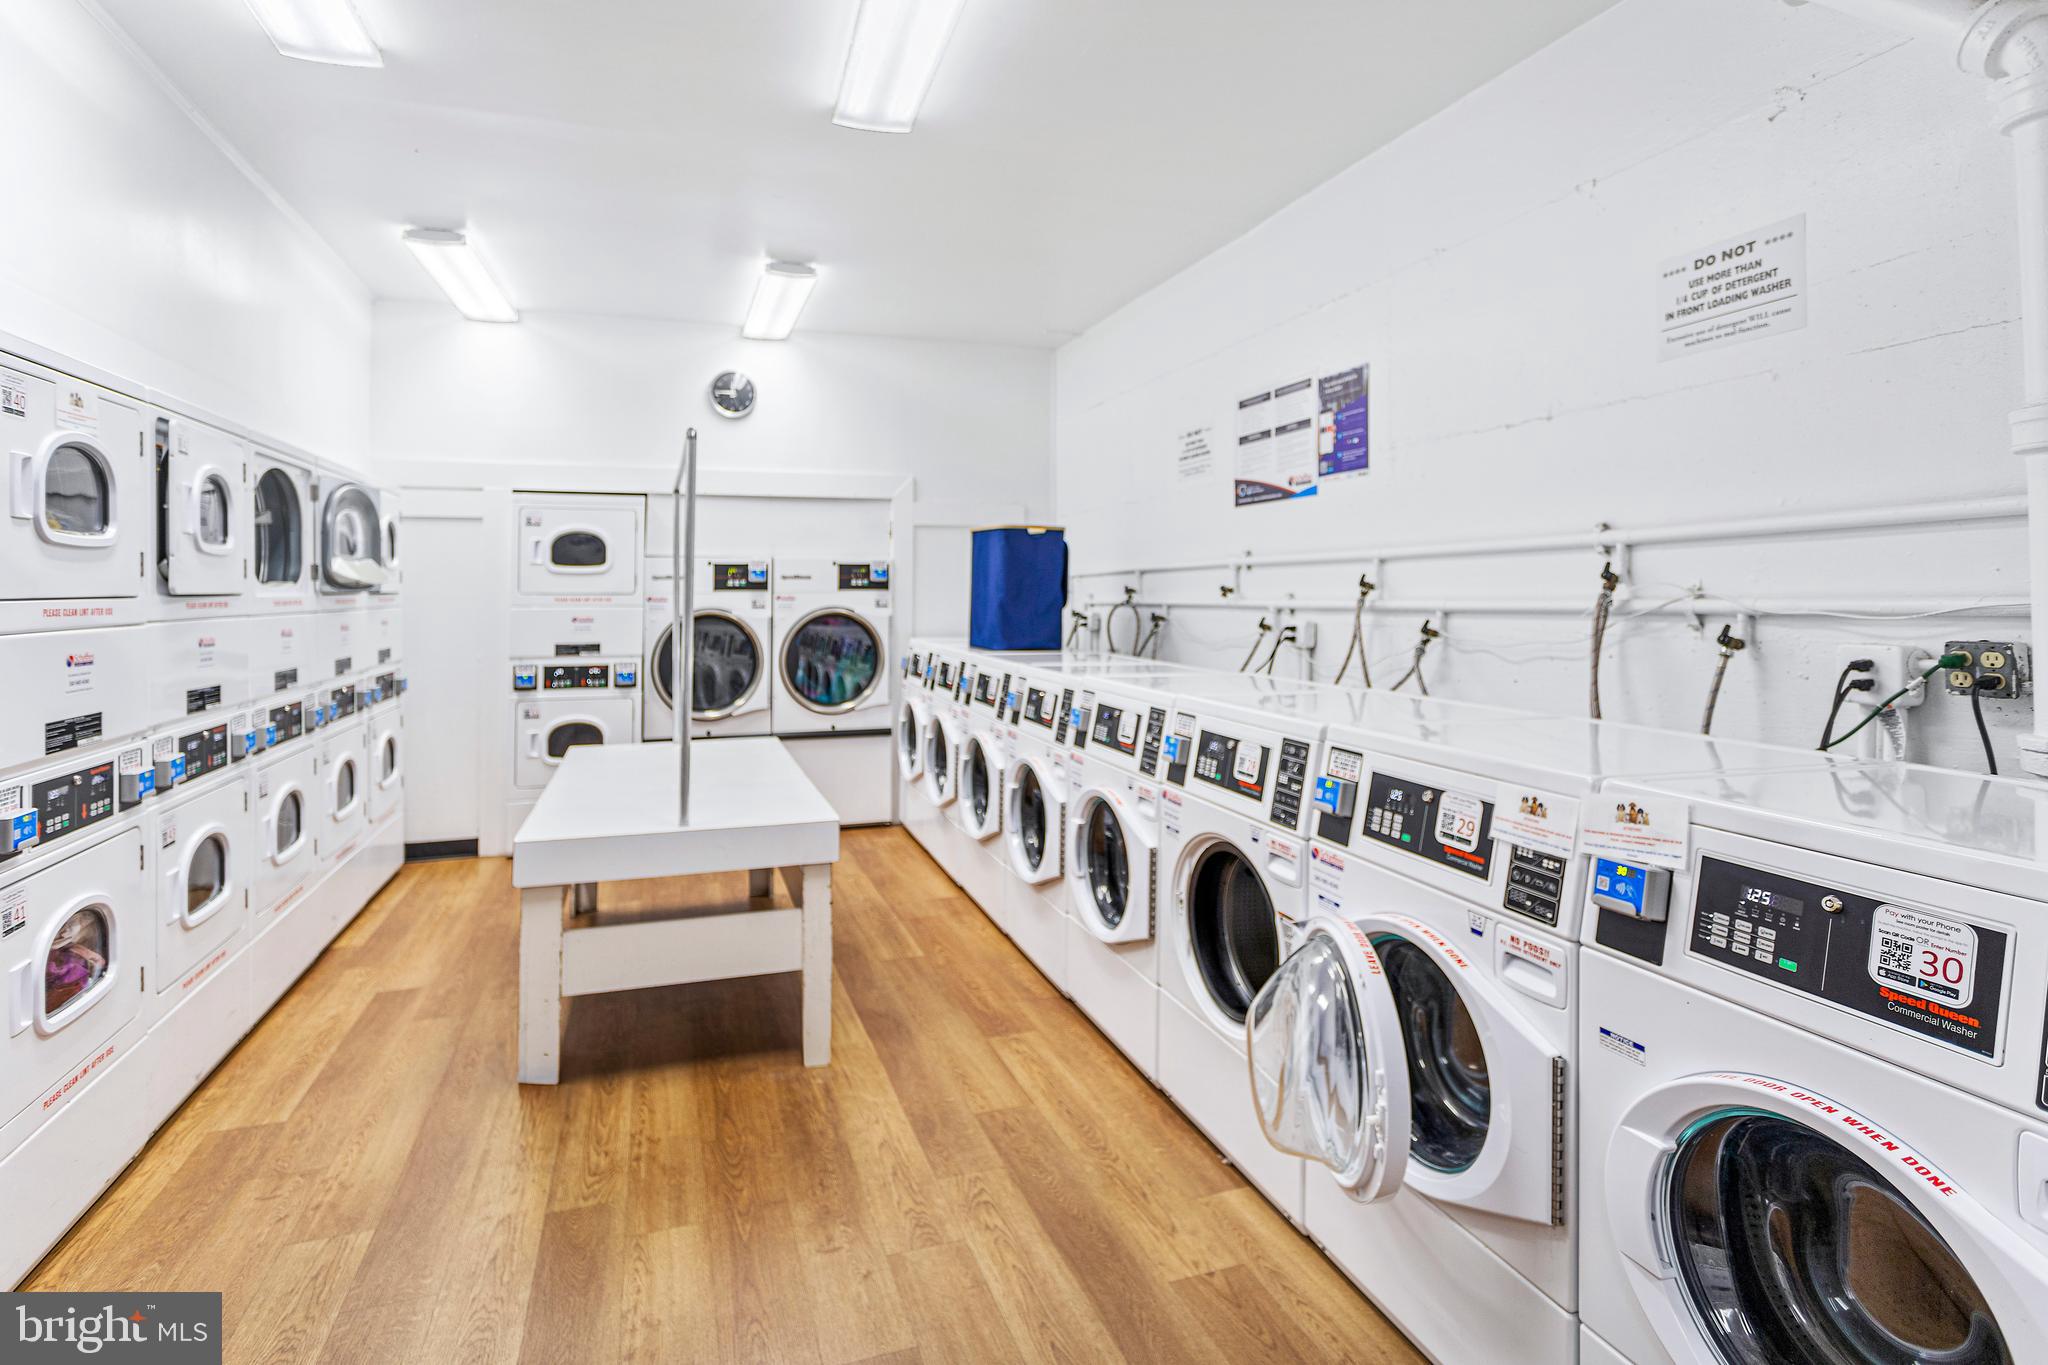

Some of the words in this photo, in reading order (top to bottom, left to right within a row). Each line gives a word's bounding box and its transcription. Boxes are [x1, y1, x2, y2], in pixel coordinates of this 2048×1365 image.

[1694, 254, 1716, 271] DO
[1721, 240, 1757, 262] NOT
[1688, 276, 1704, 289] USE
[1706, 268, 1732, 283] MORE
[1735, 258, 1762, 275] THAN
[1691, 289, 1708, 301] CUP
[1711, 284, 1722, 295] OF
[1725, 267, 1778, 291] DETERGENT
[1665, 312, 1674, 321] IN
[1676, 303, 1705, 318] FRONT
[1707, 290, 1749, 310] LOADING
[1750, 278, 1792, 297] WASHER
[1456, 817, 1476, 837] 29
[1885, 908, 1900, 918] Pay
[1900, 910, 1916, 922] with
[1917, 916, 1935, 927] your
[1936, 921, 1962, 934] Phone
[1510, 935, 1520, 946] NO
[1900, 933, 1915, 942] Code
[1916, 936, 1930, 946] OR
[1930, 942, 1944, 951] Enter
[1945, 945, 1968, 957] Number
[1919, 950, 1964, 984] 30
[1879, 986, 1927, 1010] Speed
[1928, 1000, 1980, 1028] Queen
[1929, 985, 1946, 995] Google
[1946, 990, 1957, 998] Play
[1887, 1001, 1940, 1027] Commercial
[1941, 1017, 1978, 1039] Washer
[1743, 1077, 1788, 1092] DOOR
[1790, 1091, 1839, 1115] OPEN
[1842, 1115, 1900, 1152] WHEN
[1900, 1155, 1958, 1197] DONE
